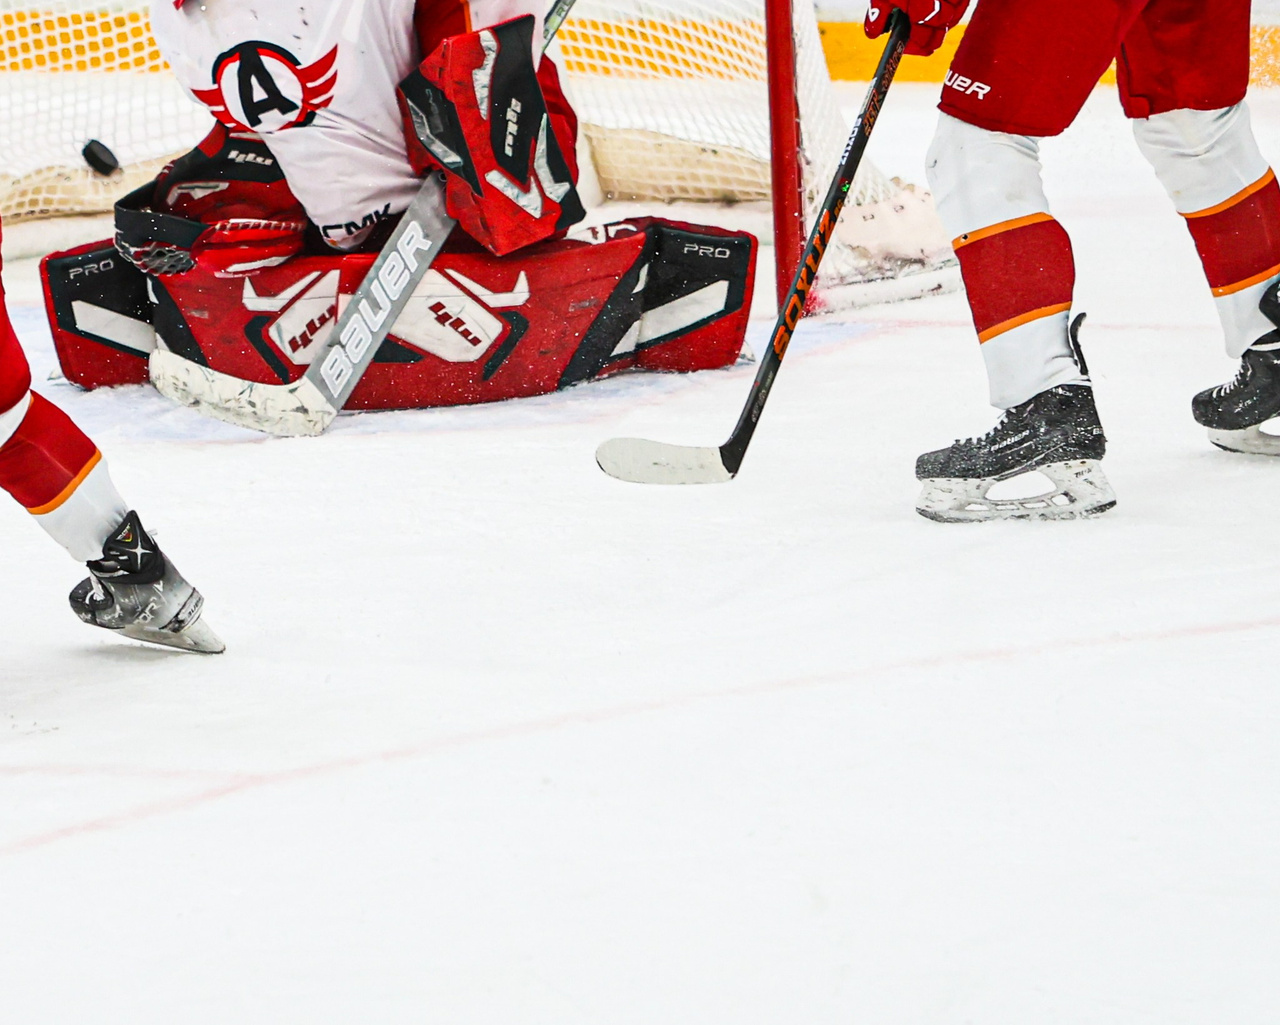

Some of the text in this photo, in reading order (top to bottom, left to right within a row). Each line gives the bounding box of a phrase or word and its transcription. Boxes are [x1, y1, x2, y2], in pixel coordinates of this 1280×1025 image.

[944, 68, 991, 101] UER
[320, 202, 392, 238] ГМК
[683, 243, 731, 259] PRO
[68, 257, 114, 280] PRO
[320, 220, 433, 399] BAUER
